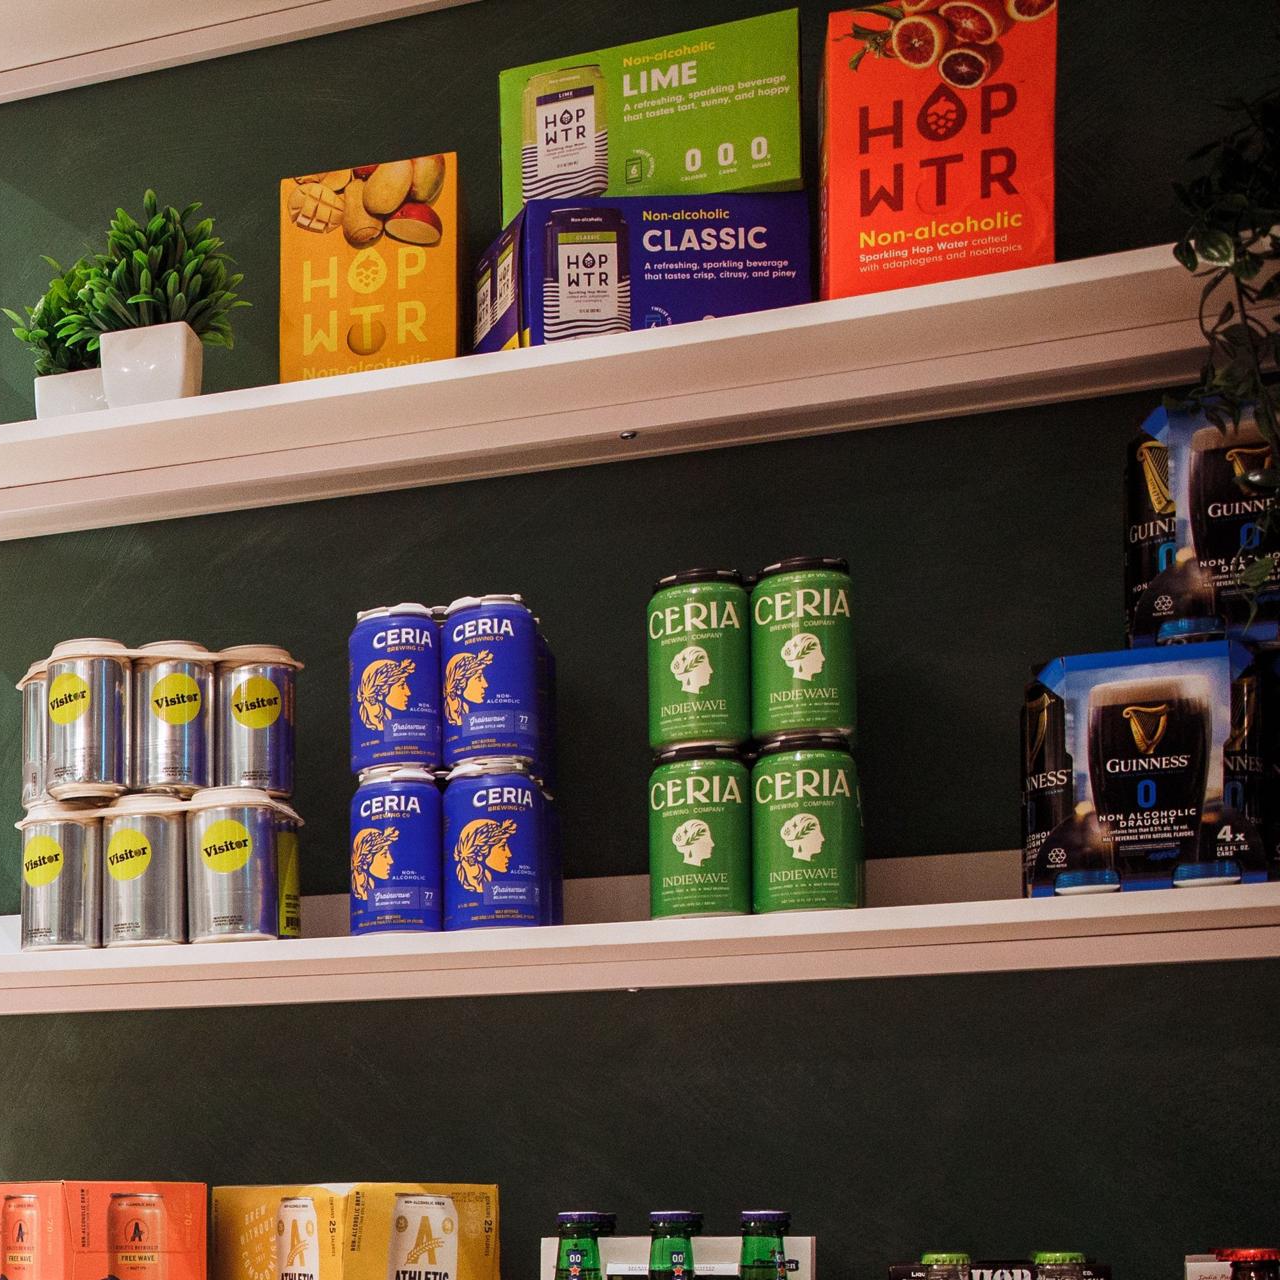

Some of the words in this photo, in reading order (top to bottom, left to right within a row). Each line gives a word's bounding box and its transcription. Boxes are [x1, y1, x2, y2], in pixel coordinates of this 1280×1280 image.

[623, 40, 716, 68] Non-alcoholic
[623, 61, 697, 97] LIME
[546, 124, 586, 146] WTR
[860, 147, 1019, 217] WTR
[643, 209, 729, 221] Non-alcoholic
[643, 227, 767, 252] CLASSIC
[859, 211, 1023, 248] Non-alcoholic
[859, 249, 908, 263] Sparkling
[912, 244, 933, 255] Hop
[937, 240, 968, 250] Water
[972, 234, 1007, 246] crafted
[568, 272, 609, 287] WTR
[303, 300, 428, 357] WTR
[755, 588, 850, 626] CERIA
[453, 618, 514, 643] CERIA
[649, 601, 740, 640] CERIA
[770, 622, 799, 632] BREWING
[373, 628, 432, 649] CERIA
[661, 637, 687, 646] BREWING
[50, 690, 86, 711] Visitor
[154, 692, 198, 709] Visitor
[234, 696, 279, 713] Visitor
[770, 688, 839, 703] INDIEWAVE
[661, 699, 726, 718] INDIEWAVE
[1106, 755, 1188, 774] GUINNESS
[651, 775, 742, 811] CERIA
[755, 768, 851, 804] CERIA
[1137, 779, 1156, 808] 0
[360, 795, 421, 818] CERIA
[473, 787, 533, 807] CERIA
[663, 809, 689, 818] BREWING
[1099, 814, 1124, 822] NON
[1129, 808, 1197, 819] ALCOHOLIC
[1120, 817, 1176, 827] DRAUGHT
[109, 846, 148, 866] Visitor
[203, 838, 249, 858] Visitor
[24, 852, 61, 874] Visitor
[662, 873, 728, 888] INDIEWAVE
[770, 868, 839, 883] INDIEWAVE
